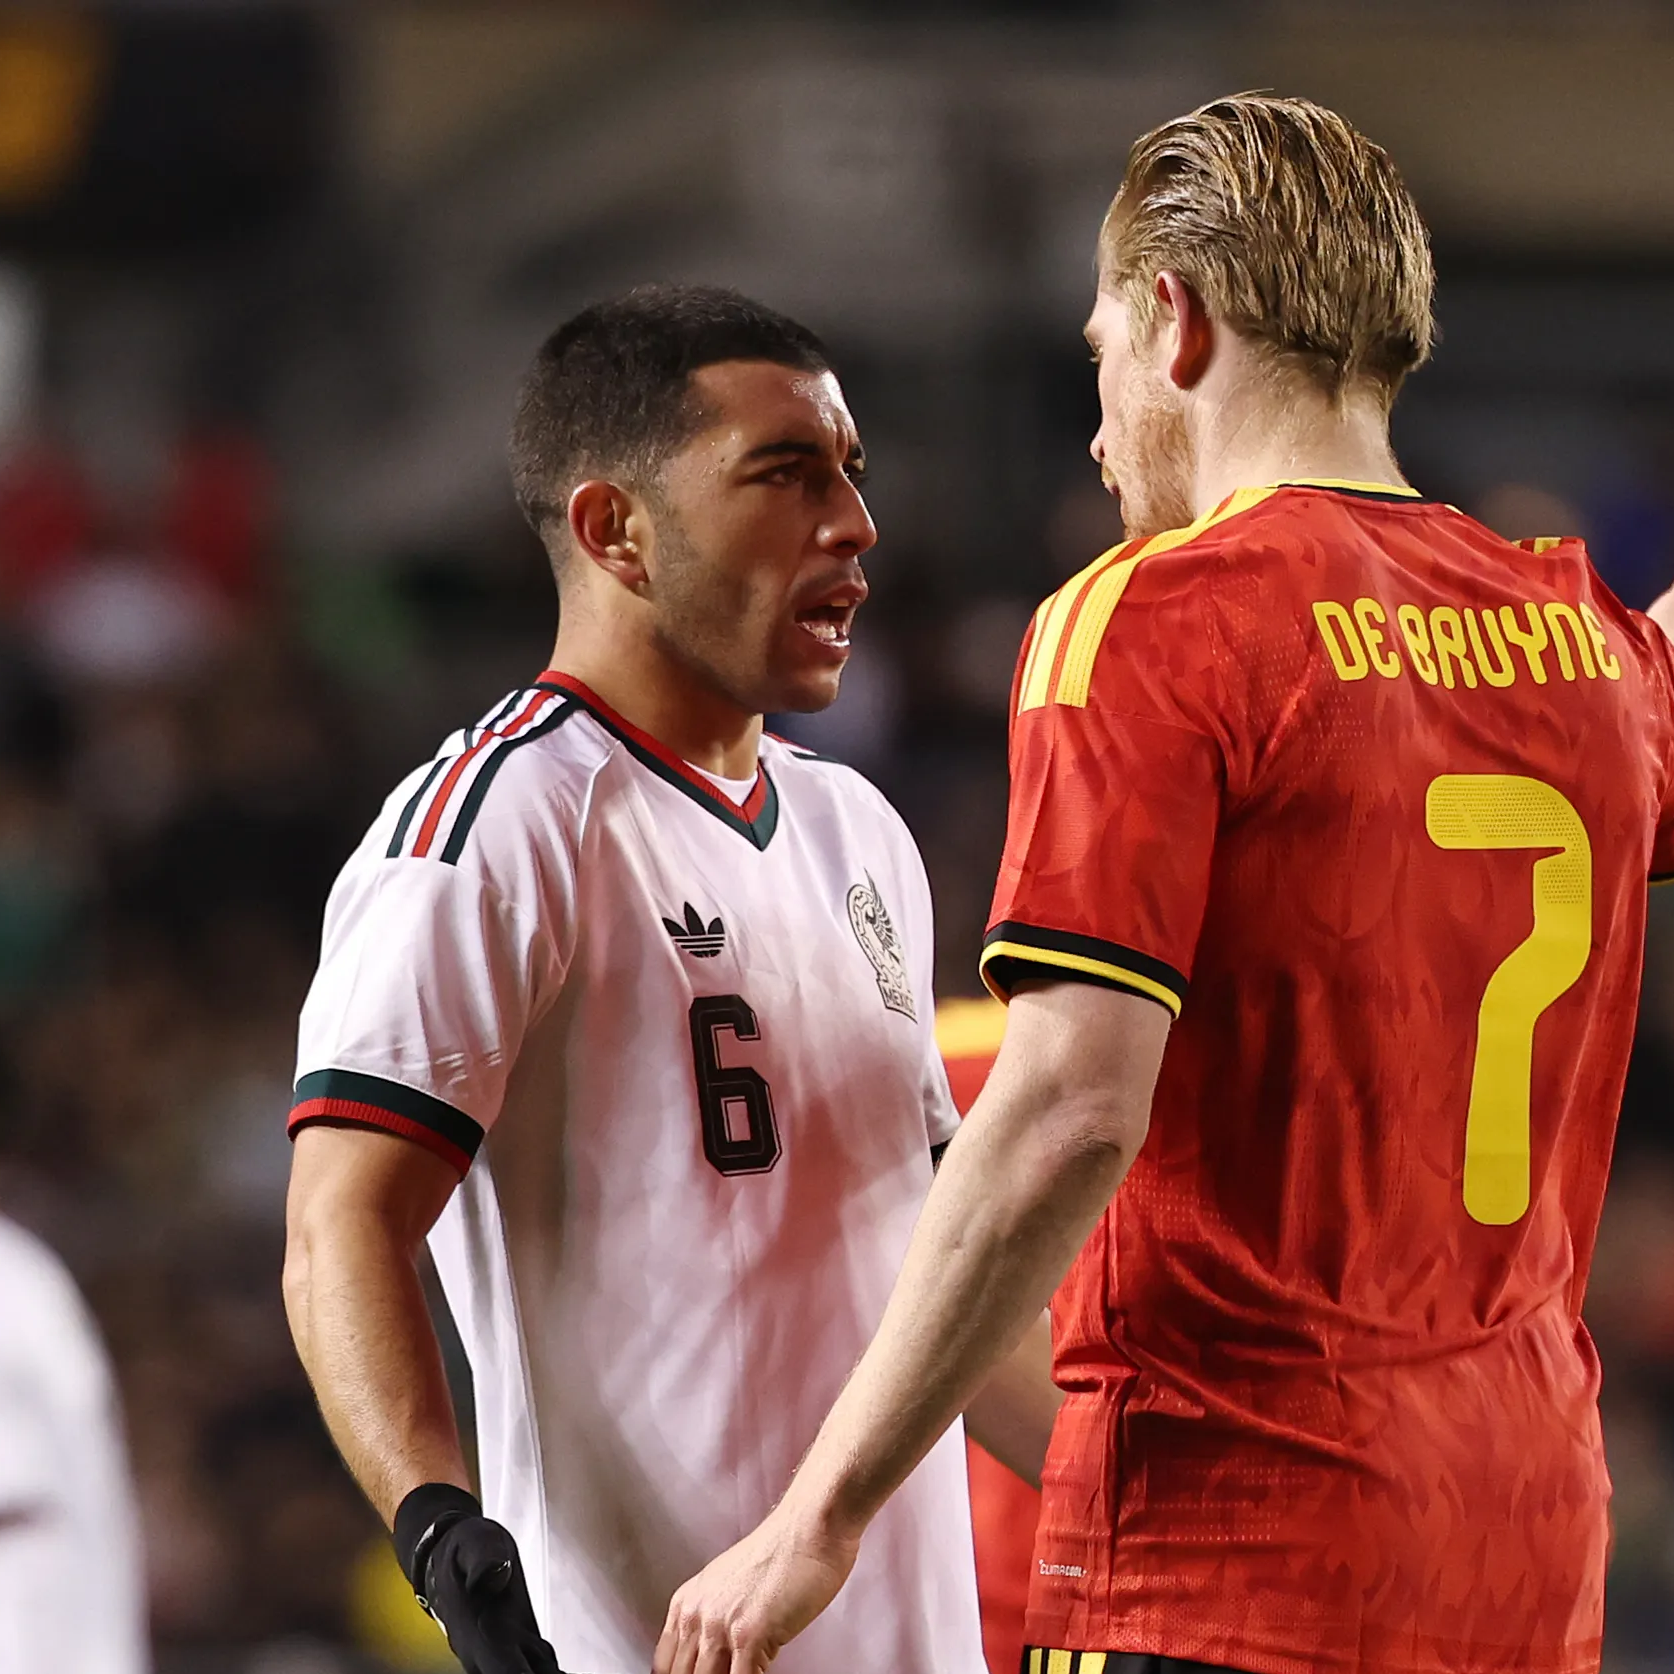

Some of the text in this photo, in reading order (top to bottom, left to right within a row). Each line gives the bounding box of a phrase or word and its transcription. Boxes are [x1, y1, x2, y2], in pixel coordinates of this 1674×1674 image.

[1312, 598, 1621, 689] DE BRUYNE
[688, 994, 782, 1177] 6
[1426, 774, 1591, 1225] 7
